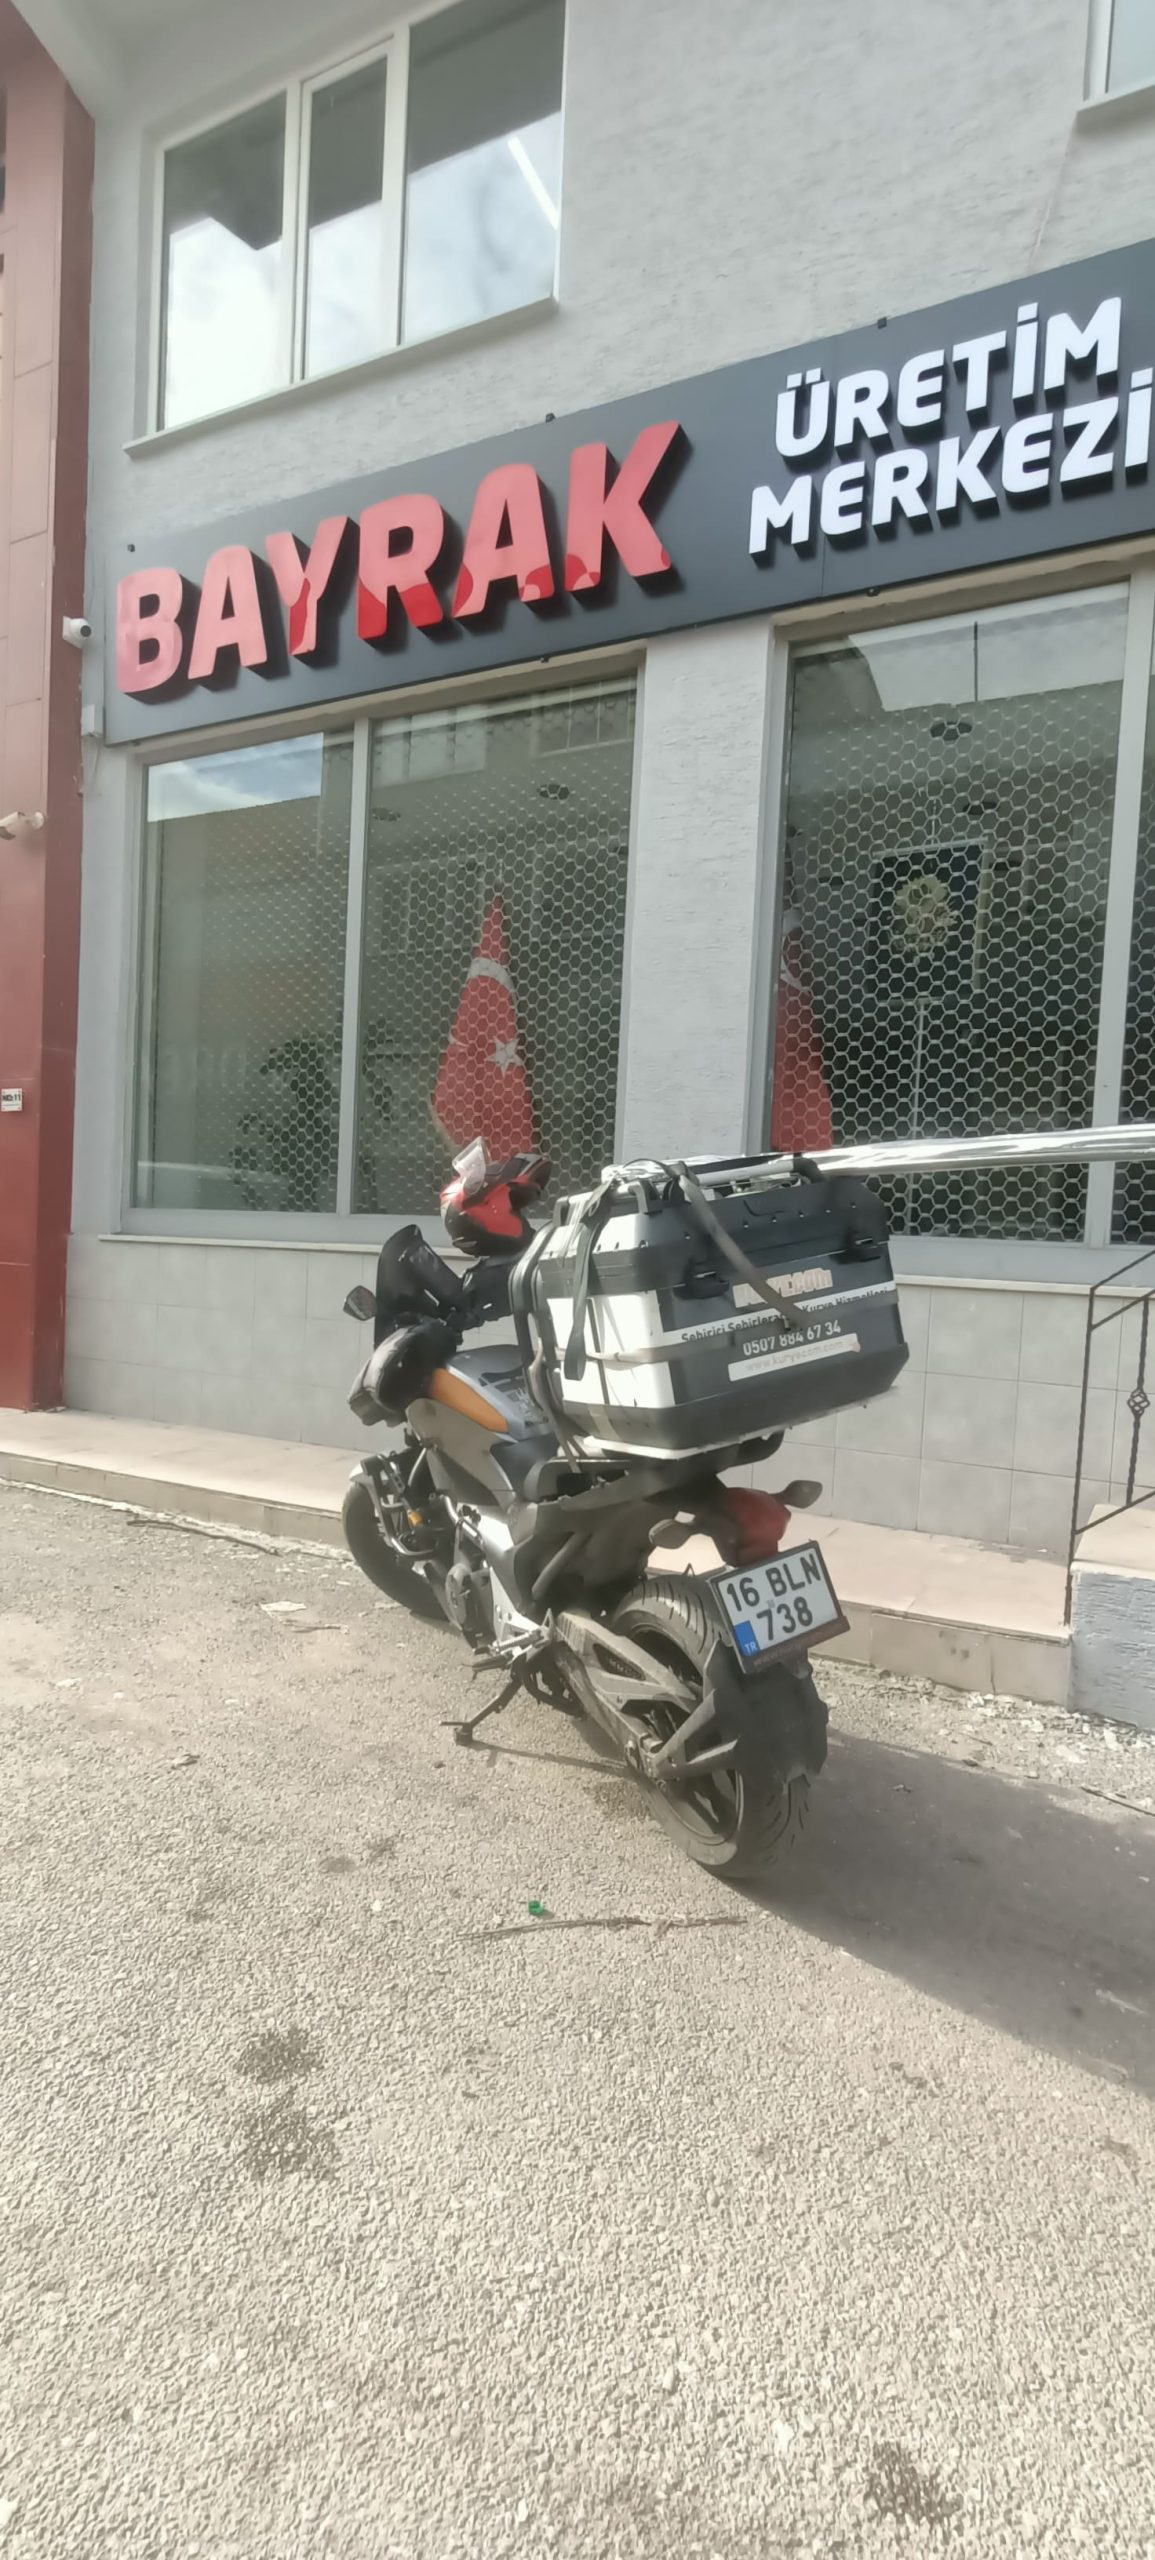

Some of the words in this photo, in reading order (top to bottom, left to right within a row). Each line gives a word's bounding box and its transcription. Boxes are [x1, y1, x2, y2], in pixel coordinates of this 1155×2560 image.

[775, 297, 1122, 457] ÜRETİM
[749, 368, 1154, 554] MERKEZİ
[117, 420, 681, 695] BAYRAK
[743, 1336, 775, 1356] 0507
[779, 1331, 804, 1348] 884
[807, 1324, 821, 1340] 67
[824, 1319, 841, 1336] 34
[727, 1577, 760, 1612] 16
[765, 1553, 821, 1597] BLN
[744, 1642, 758, 1654] TR
[756, 1596, 813, 1641] 738
